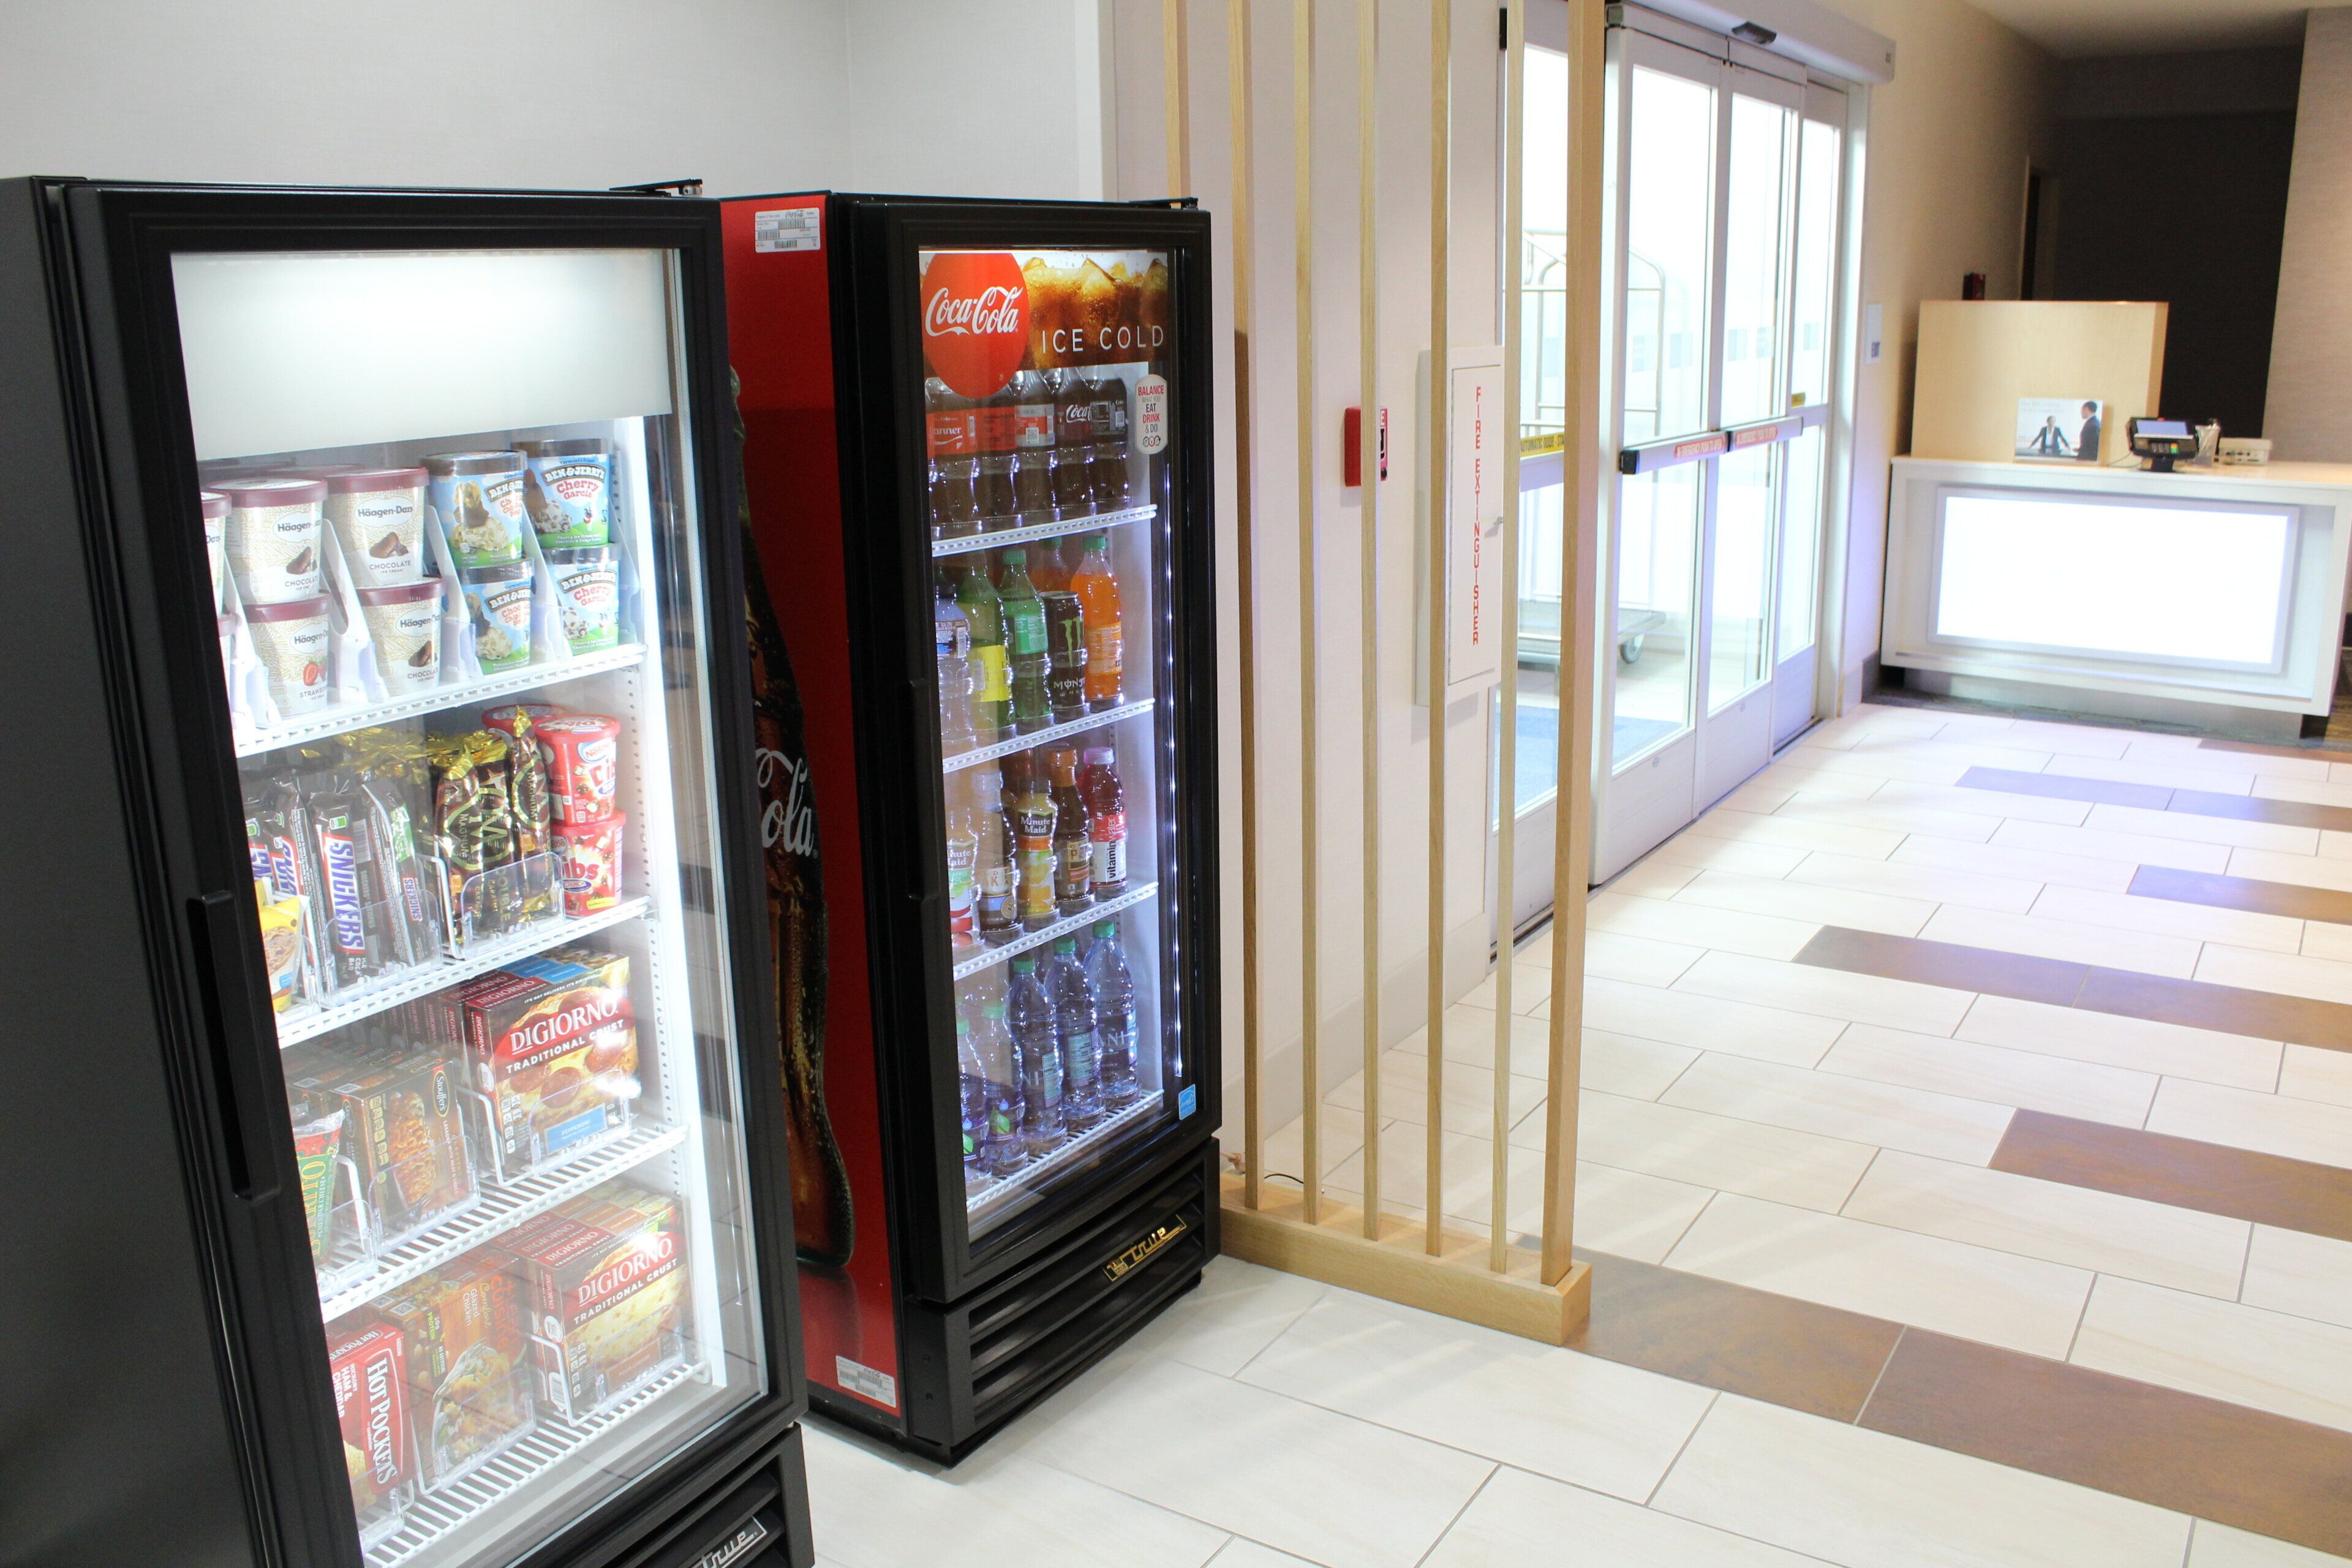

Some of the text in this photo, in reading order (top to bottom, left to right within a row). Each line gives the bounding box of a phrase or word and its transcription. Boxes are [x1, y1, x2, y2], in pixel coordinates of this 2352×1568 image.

[925, 286, 1023, 336] Coca-Cola
[1042, 325, 1163, 353] ICE COLD
[1138, 385, 1164, 396] BALANCE
[1143, 413, 1160, 423] DRINK
[1146, 403, 1156, 412] EAT
[1145, 423, 1158, 433] & DO
[556, 480, 599, 494] Cherry
[564, 489, 592, 500] Garcia
[358, 505, 413, 518] Häagen-Dazs
[369, 560, 412, 571] CHOCOLATE
[573, 586, 611, 601] Cherry
[527, 771, 538, 818] MAGNUM
[1020, 816, 1050, 825] Minute
[1025, 824, 1047, 834] Maid
[1107, 815, 1117, 879] vitaminwater
[563, 856, 600, 880] ibs
[328, 842, 364, 948] SNICKERS
[403, 878, 422, 920] SNICKERS
[477, 980, 535, 1004] DIGIORNO
[475, 1016, 486, 1055] DIGIORNO
[510, 997, 619, 1054] DIGIORNO
[506, 1019, 624, 1074] TRADITIONAL CRUST
[436, 1076, 447, 1112] Stouffer's
[561, 1119, 591, 1136] PEPPERONI
[522, 1223, 575, 1253] DIGIORNO
[545, 1231, 598, 1261] DIGIORNO
[555, 1234, 611, 1267] TRADITIONAL CRUST
[1120, 1227, 1182, 1268] true
[578, 1237, 673, 1305] DIGIORNO
[470, 1287, 480, 1317] Glazed
[480, 1283, 492, 1329] Comfort
[574, 1258, 677, 1325] TRADITIONAL CRUST
[462, 1292, 472, 1327] Chicken
[426, 1311, 436, 1341] PROTEIN
[333, 1371, 345, 1419] CHEDDAR
[341, 1366, 353, 1402] HAM &
[368, 1357, 398, 1485] HOT POCKETS
